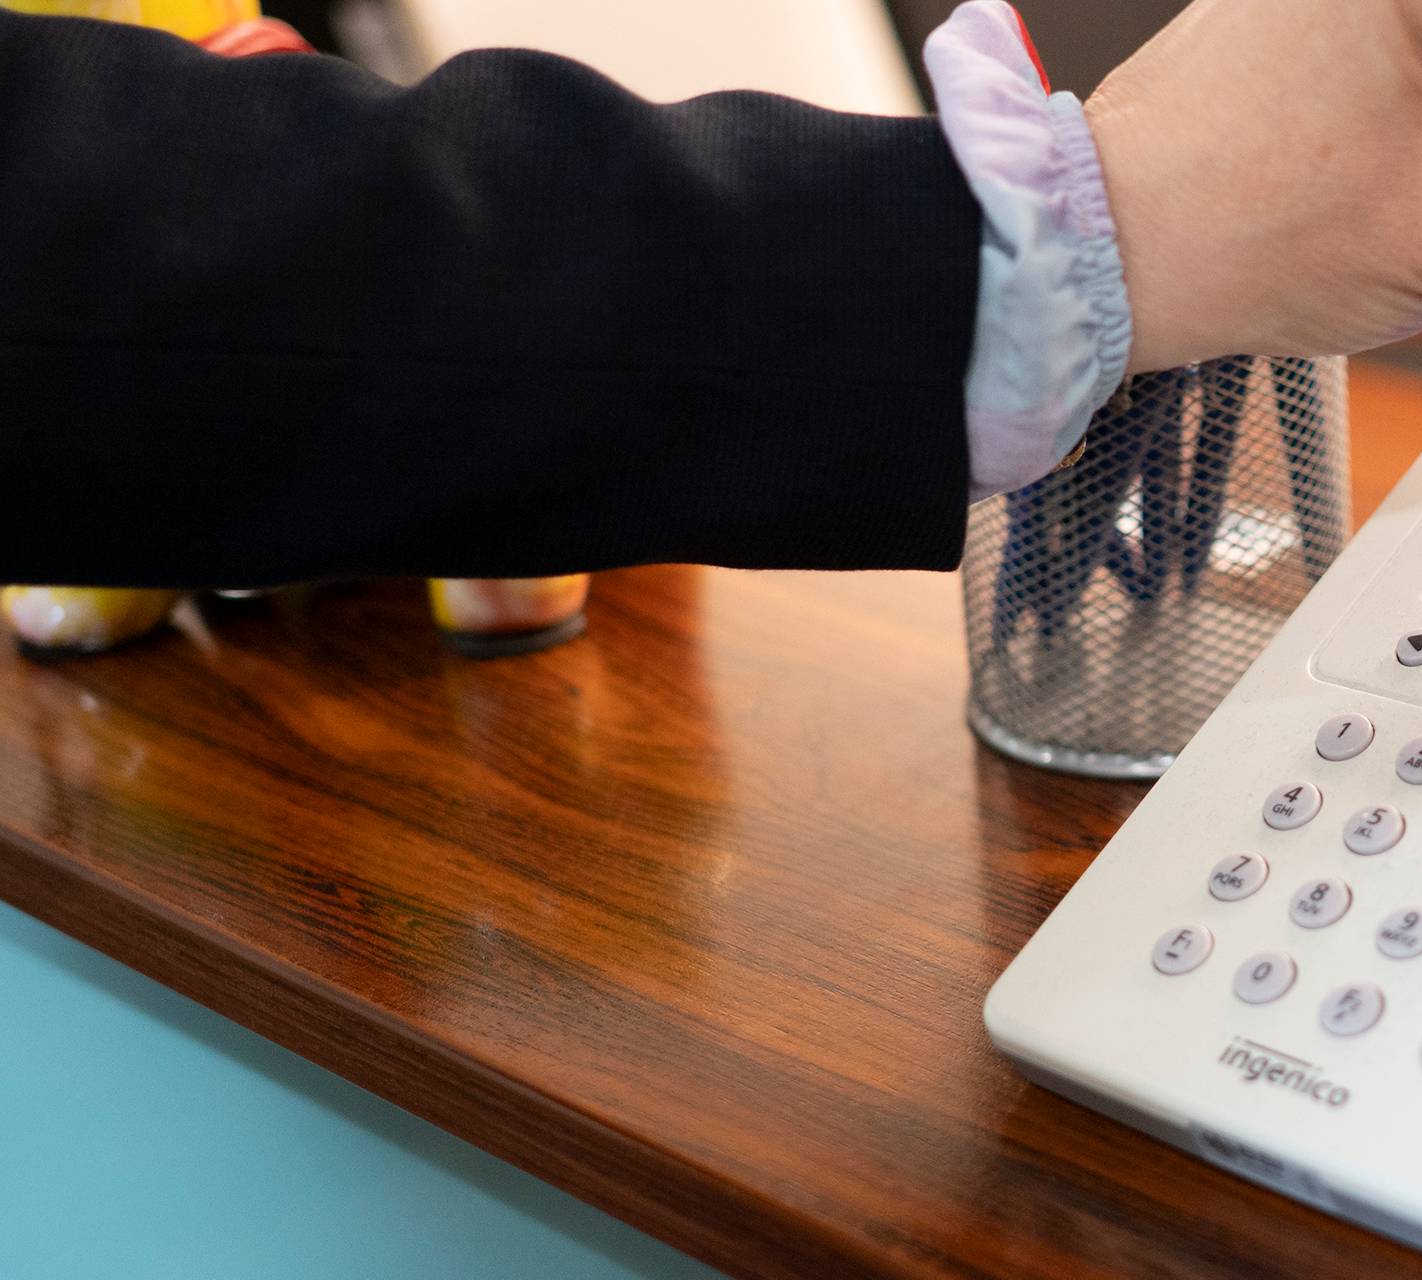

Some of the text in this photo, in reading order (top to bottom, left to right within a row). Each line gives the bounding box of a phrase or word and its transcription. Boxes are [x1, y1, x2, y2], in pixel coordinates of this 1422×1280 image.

[1337, 722, 1351, 738] 1
[1283, 786, 1303, 802] 4
[1272, 803, 1294, 816] GHI
[1366, 808, 1388, 825] 5
[1231, 856, 1251, 872] 7
[1214, 872, 1245, 888] PQRS
[1310, 883, 1330, 901] 8
[1401, 912, 1420, 930] 9
[1253, 962, 1272, 981] 0
[1217, 1037, 1351, 1107] ingenico
